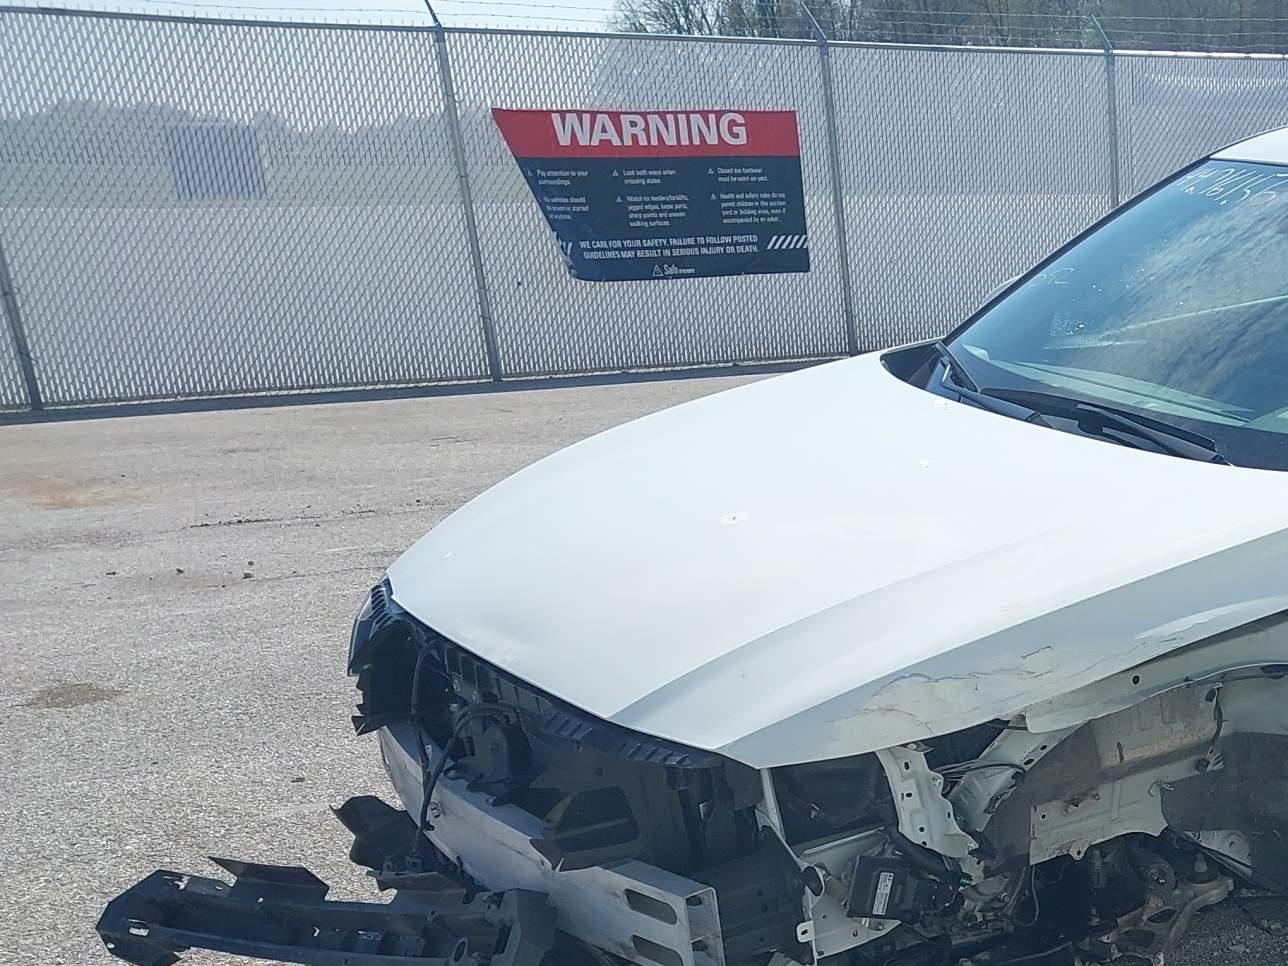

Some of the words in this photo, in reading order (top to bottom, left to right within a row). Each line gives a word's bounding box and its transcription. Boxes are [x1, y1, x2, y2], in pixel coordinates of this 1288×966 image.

[551, 112, 748, 147] WARNING
[592, 240, 608, 248] CARE
[608, 240, 622, 248] FOR
[622, 239, 641, 247] YOUR
[670, 237, 696, 245] FAILURE
[706, 236, 732, 244] FOLLOW
[733, 235, 758, 243] POSTED
[583, 251, 620, 259] GUIDELINES
[672, 248, 699, 256] SERIOUS
[700, 246, 724, 255] INJURY
